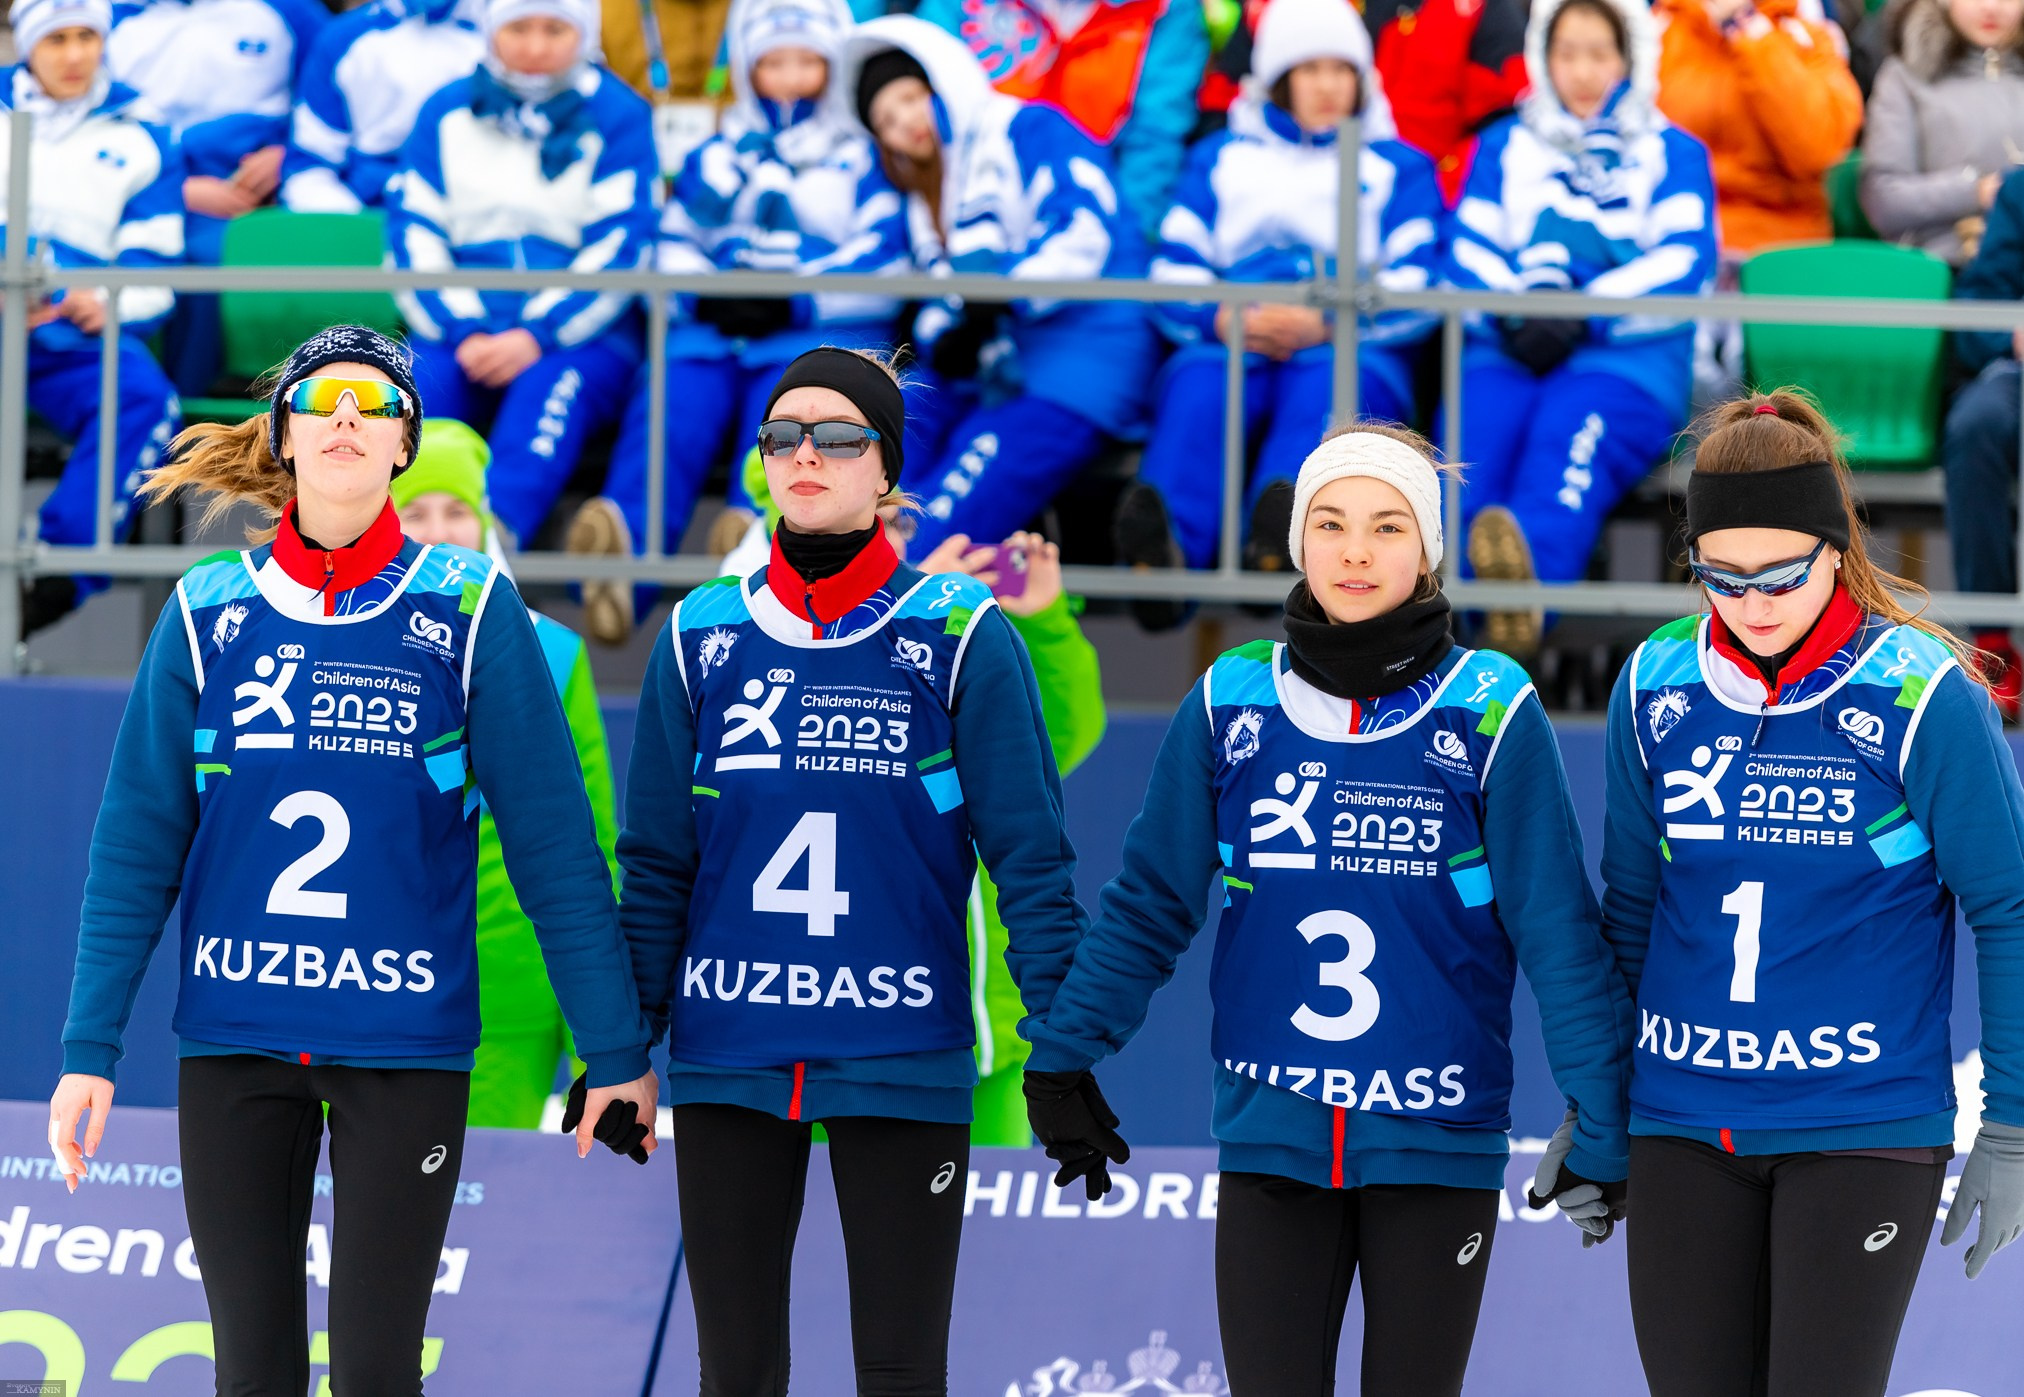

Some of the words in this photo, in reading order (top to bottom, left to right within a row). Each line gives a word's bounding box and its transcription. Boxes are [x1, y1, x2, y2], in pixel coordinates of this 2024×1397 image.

[344, 663, 383, 671] INTERNATIONAL
[312, 671, 372, 687] Children
[374, 677, 390, 689] of
[390, 678, 420, 695] Asia
[310, 692, 417, 734] 2023
[801, 694, 861, 708] Children
[863, 698, 879, 709] of
[879, 699, 911, 714] Asia
[309, 735, 413, 758] KUZBASS
[797, 715, 909, 753] 2023
[796, 755, 906, 777] KUZBASS
[1425, 751, 1456, 767] CHILDREN
[1745, 763, 1805, 777] Children
[1807, 766, 1822, 778] of
[1823, 767, 1856, 781] Asia
[1334, 790, 1394, 806] Children
[1397, 796, 1412, 808] of
[1413, 797, 1443, 812] Asia
[1365, 782, 1406, 790] INTERNATIONAL
[1739, 784, 1855, 823] 2023
[1332, 812, 1442, 853] 2023
[1738, 826, 1853, 845] KUZBASS
[265, 790, 351, 919] 2
[1331, 855, 1437, 876] KUZBASS
[752, 812, 849, 937] 4
[1721, 880, 1764, 1002] 1
[194, 935, 434, 992] KUZBASS
[1290, 909, 1380, 1041] 3
[684, 956, 933, 1008] KUZBASS
[1637, 1008, 1881, 1071] KUZBASS
